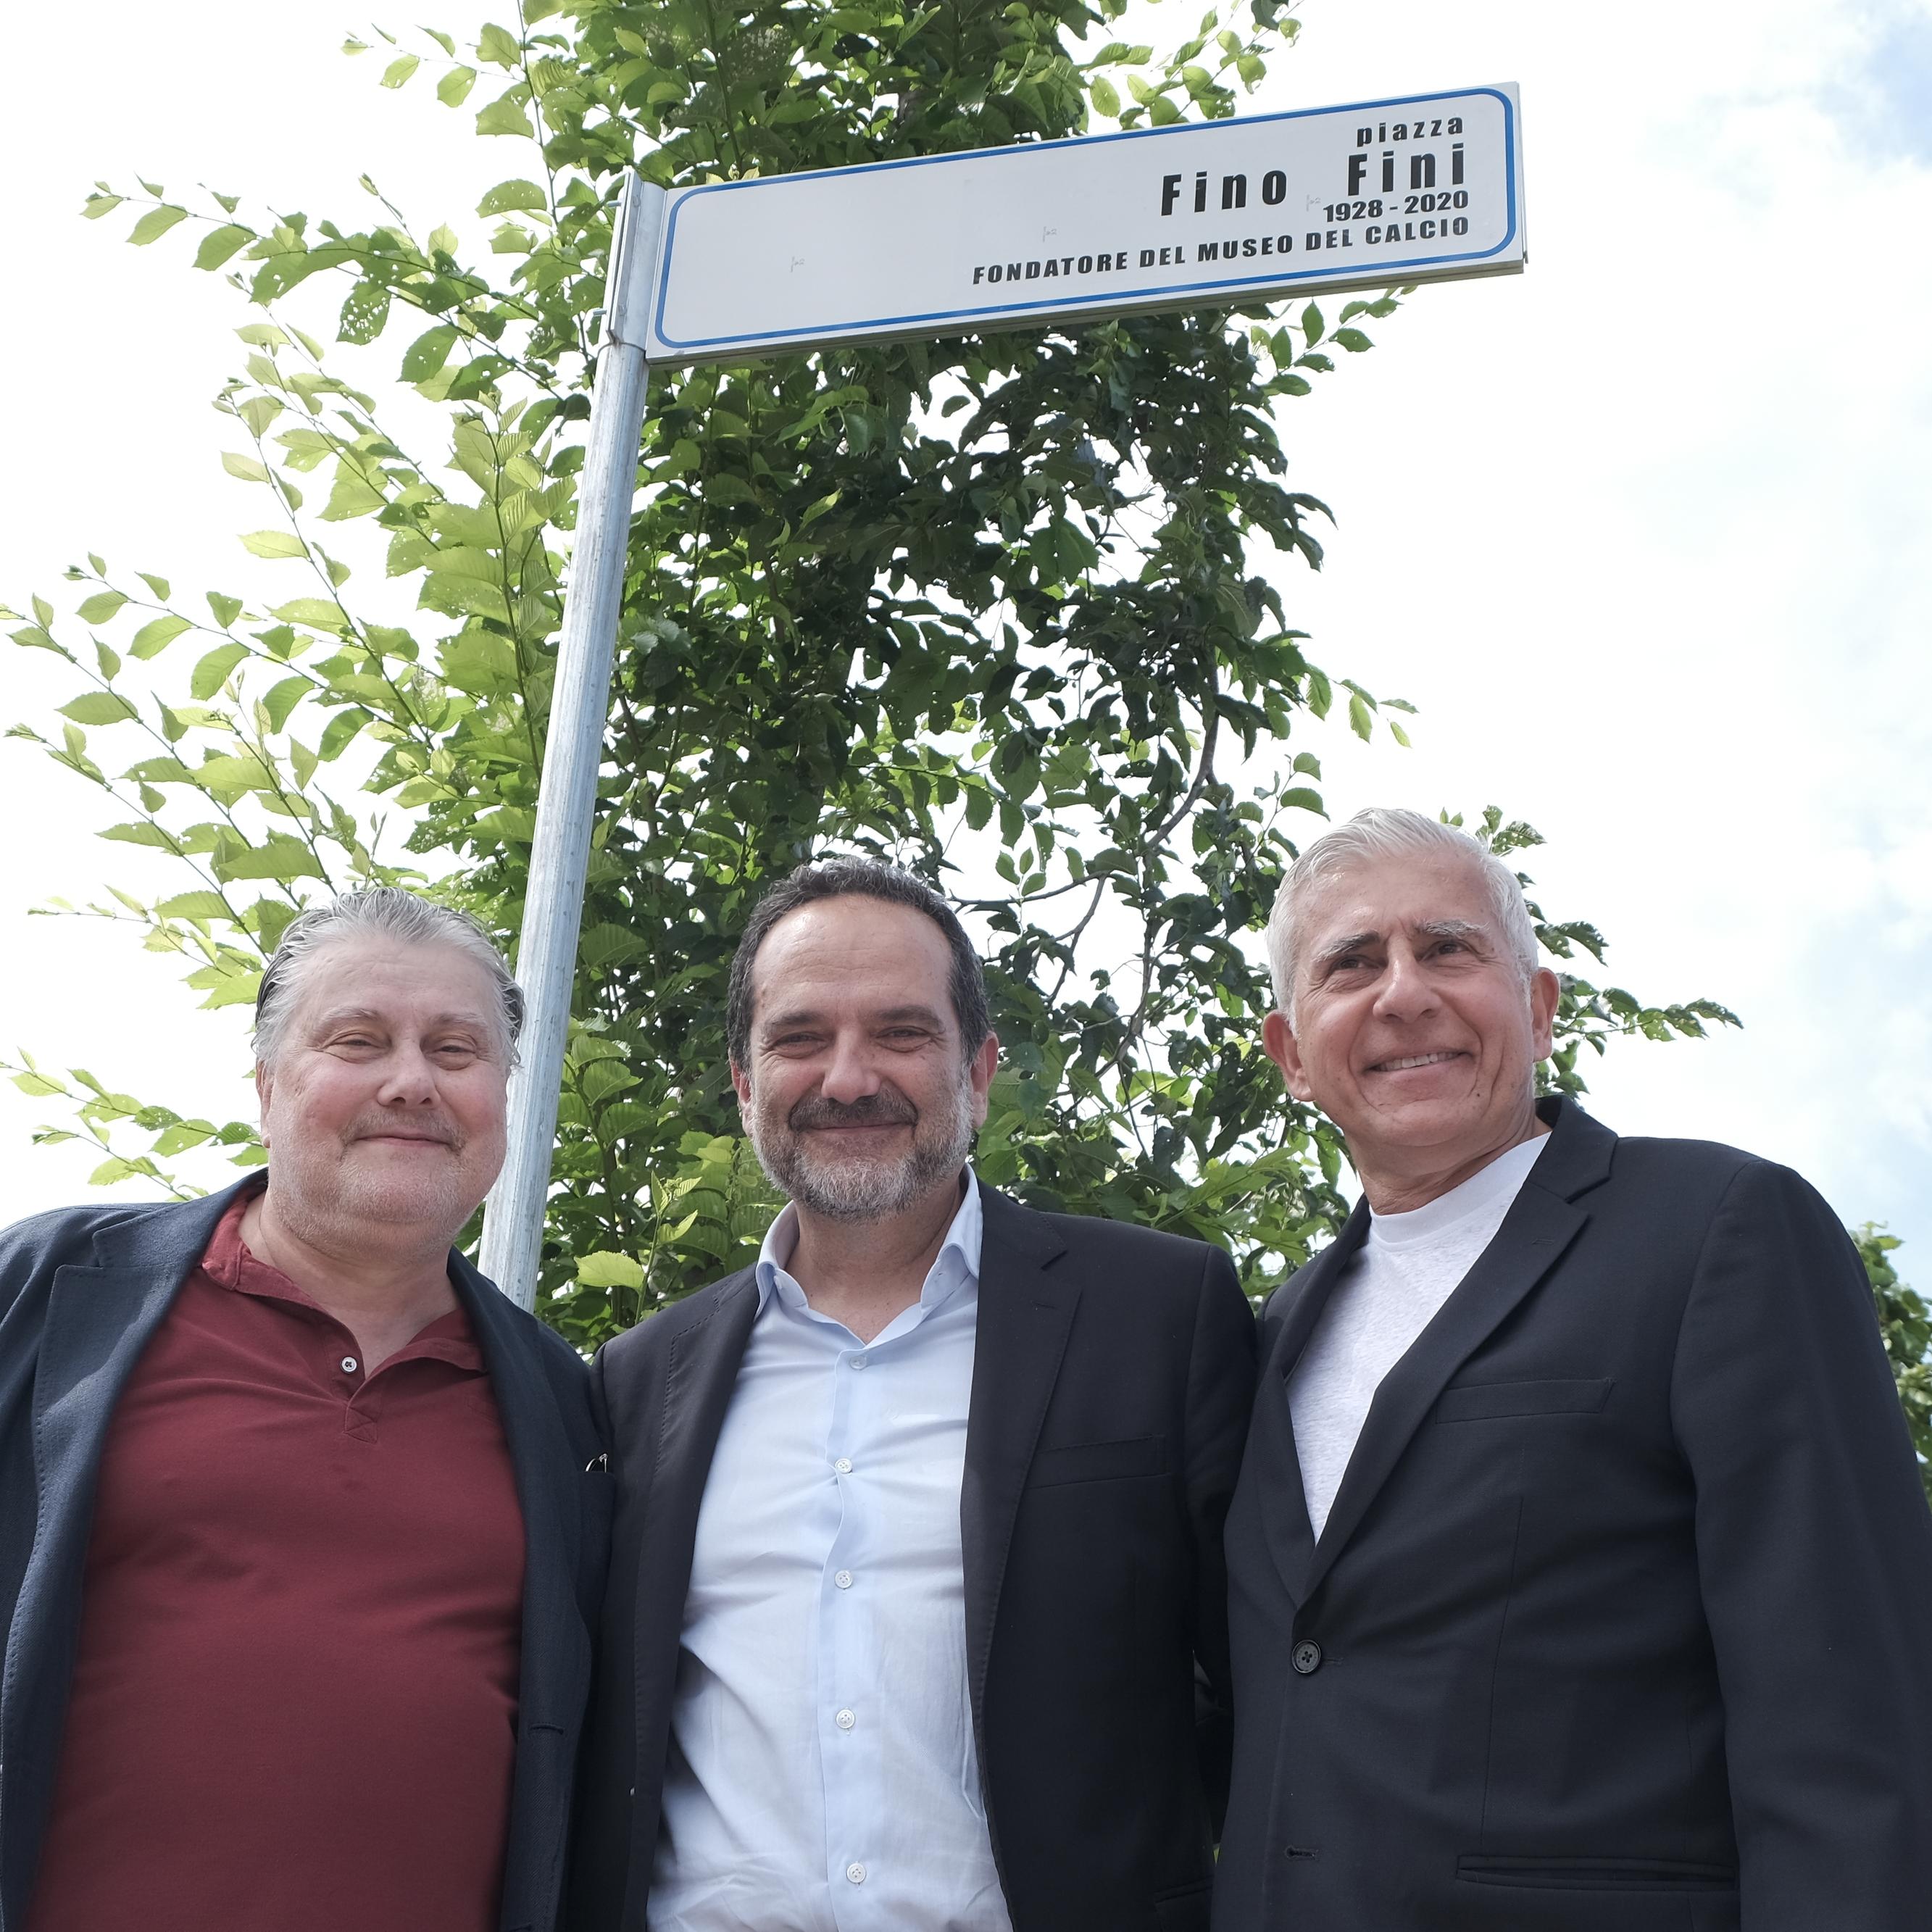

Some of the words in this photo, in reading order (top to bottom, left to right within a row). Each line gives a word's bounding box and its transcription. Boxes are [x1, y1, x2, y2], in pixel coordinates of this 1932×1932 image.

[1357, 117, 1462, 148] piazza
[1161, 170, 1288, 217] Fino
[1347, 143, 1465, 196] Fini
[1323, 199, 1383, 222] 1928
[1404, 190, 1468, 215] 2020
[973, 251, 1128, 285] FONDATORE
[1139, 246, 1186, 268] DEL
[1198, 234, 1293, 262] MUSEO
[1305, 229, 1353, 251] DEL
[1365, 217, 1469, 244] CALCIO
